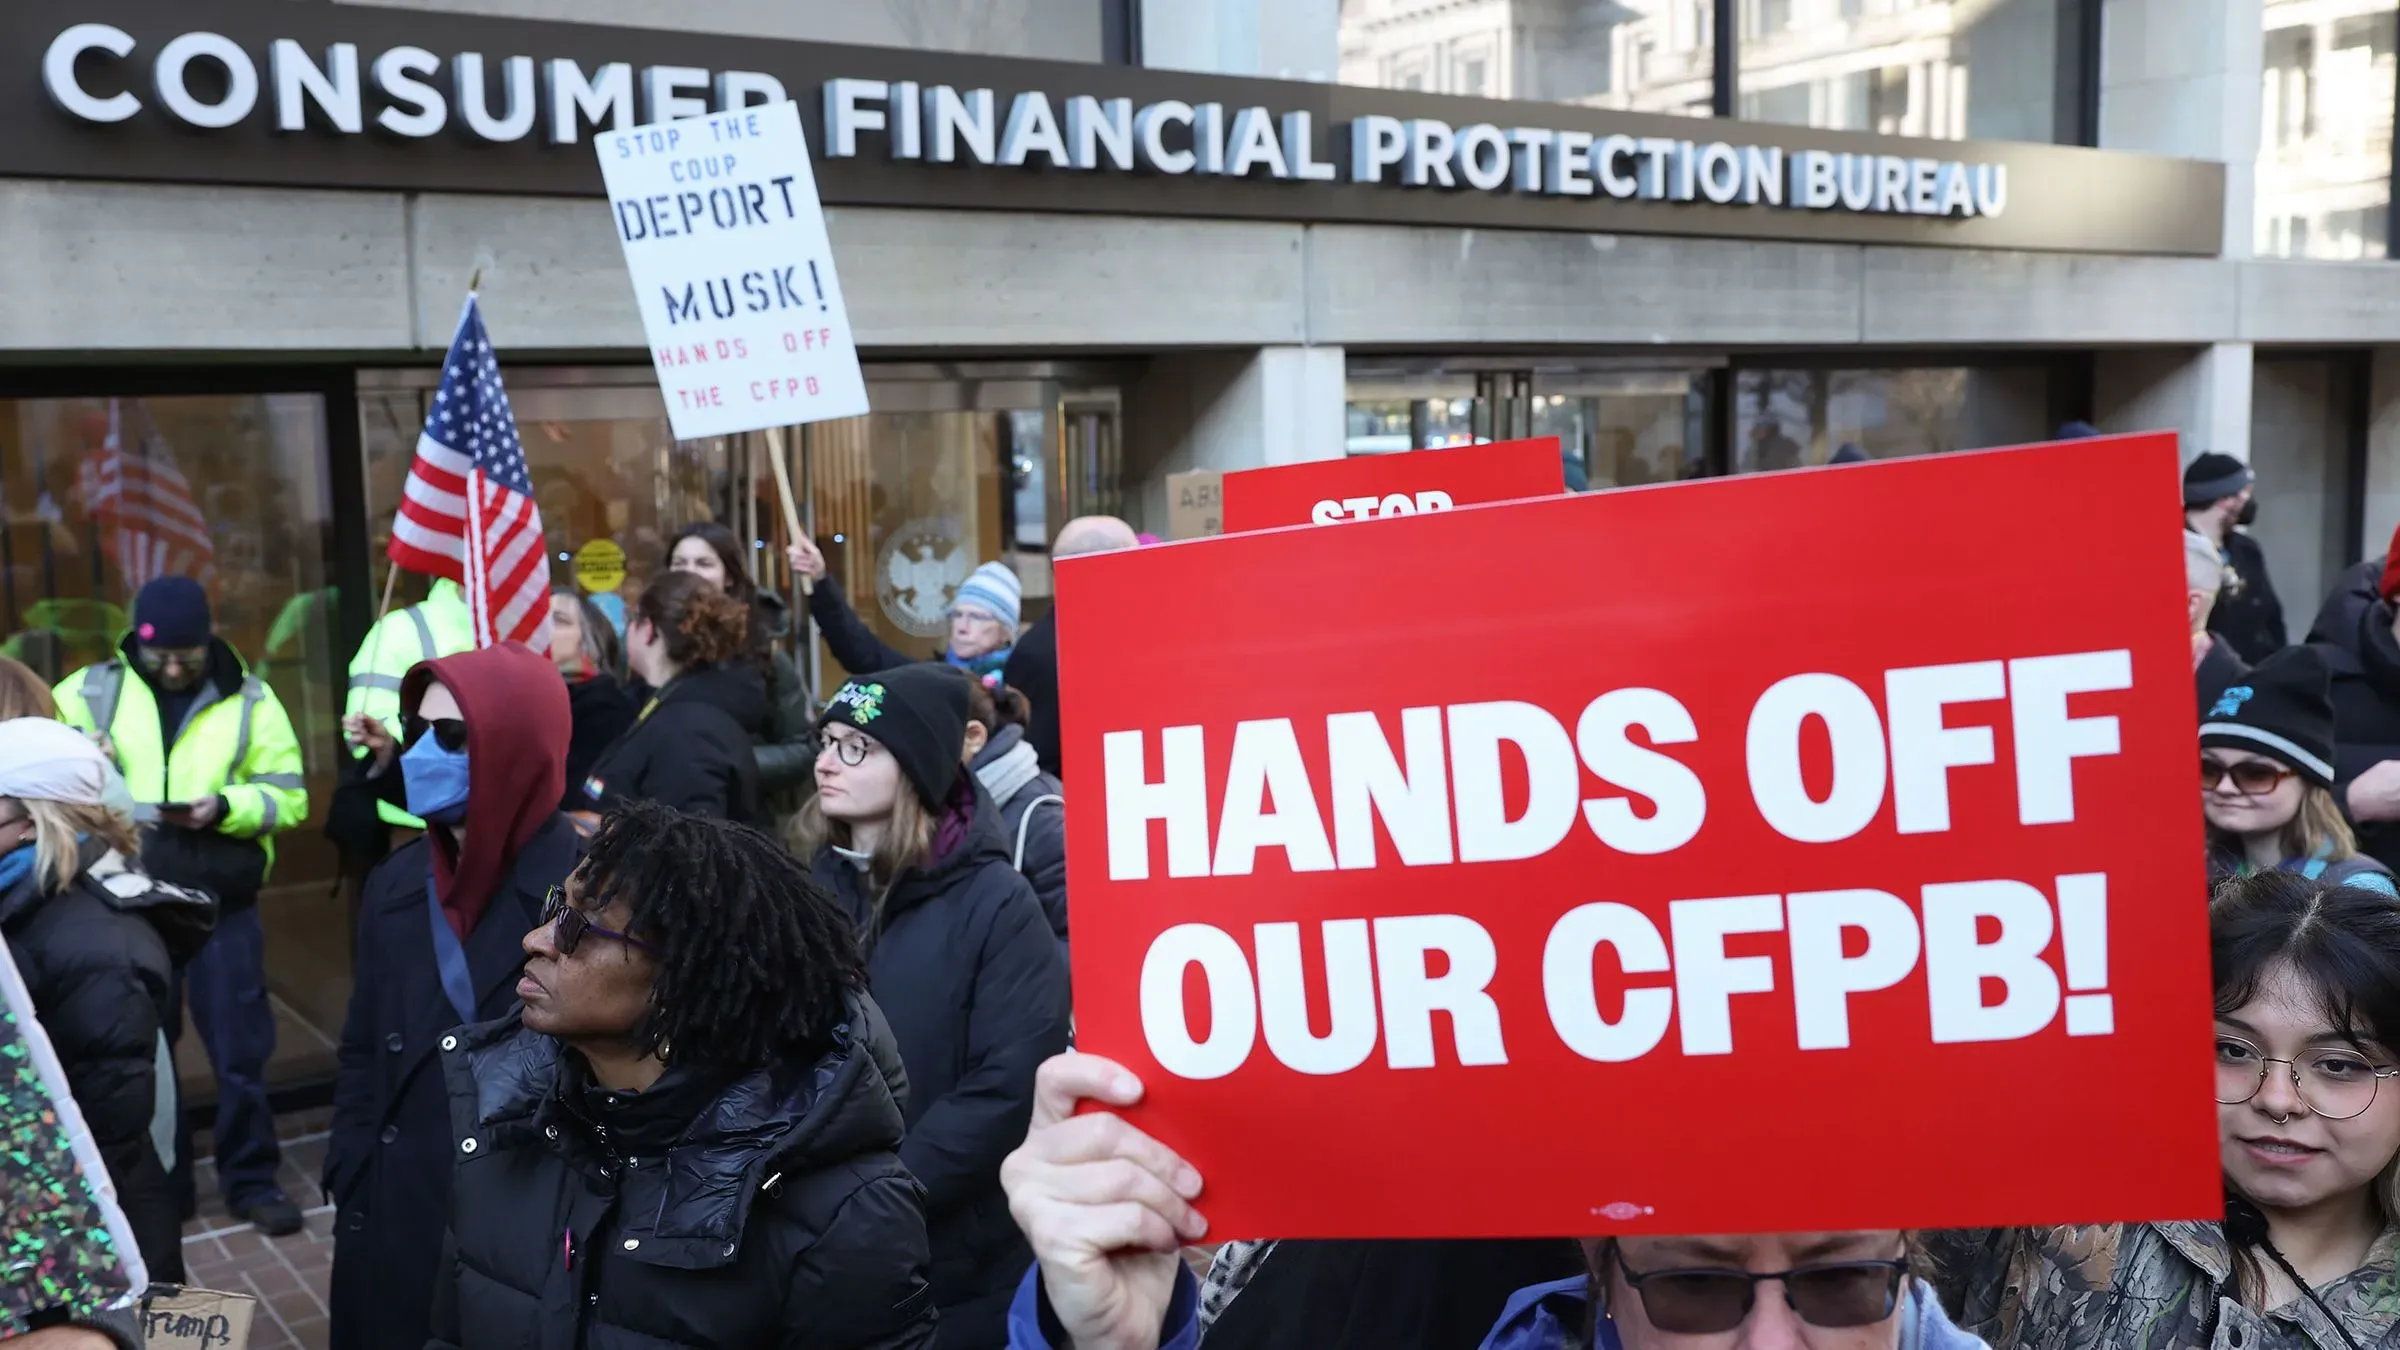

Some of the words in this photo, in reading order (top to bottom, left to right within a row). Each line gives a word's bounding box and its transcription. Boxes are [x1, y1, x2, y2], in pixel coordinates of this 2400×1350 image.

[615, 128, 680, 159] STOP
[709, 114, 762, 142] THE
[670, 154, 736, 182] COUP
[823, 77, 1336, 182] FINANCIAL
[1351, 115, 1783, 207] PROTECTION
[1790, 149, 2008, 219] BUREAU
[617, 175, 796, 241] DEPORT
[661, 260, 828, 324] MUSK!
[658, 338, 748, 367] HANDS
[782, 328, 831, 353] OFF
[677, 386, 723, 410] THE
[750, 376, 820, 402] CFPB
[1102, 686, 1707, 881] HANDS
[1745, 649, 2133, 843] OFF
[1139, 912, 1509, 1079] OUR
[1542, 871, 2114, 1062] CFPB!
